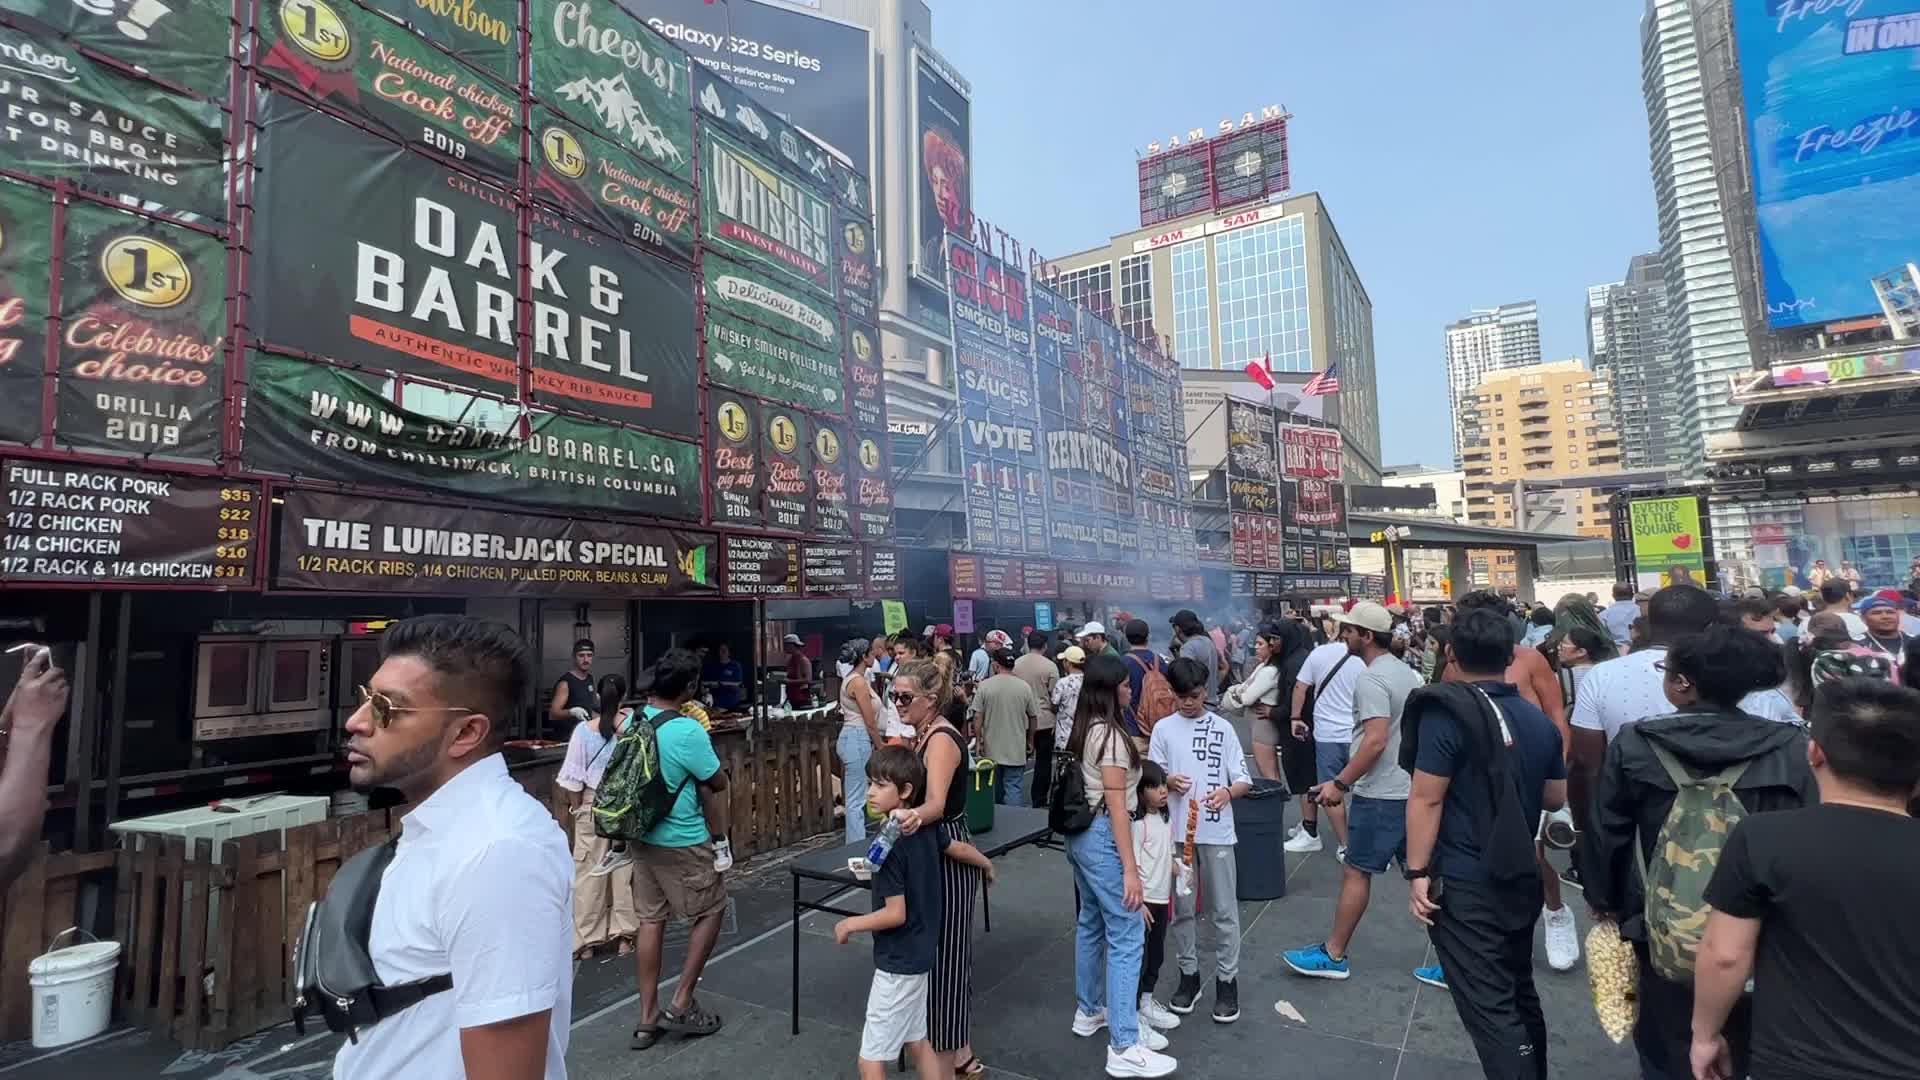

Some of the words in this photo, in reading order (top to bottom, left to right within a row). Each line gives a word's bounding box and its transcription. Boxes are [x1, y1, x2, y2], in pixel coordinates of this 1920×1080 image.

[554, 1, 675, 99] Cheers!
[648, 18, 723, 52] Galaxy
[762, 45, 822, 72] Series
[1846, 19, 1878, 53] IN
[370, 40, 457, 91] National
[457, 83, 516, 117] chicken
[772, 73, 796, 85] Store
[8, 104, 72, 135] FOR
[70, 102, 177, 148] SAUCE
[374, 72, 457, 120] Cook
[462, 113, 513, 145] off
[424, 127, 467, 159] 2019
[1148, 128, 1205, 154] SAM
[1219, 103, 1281, 133] SAM
[1795, 106, 1918, 163] Freezie
[41, 135, 178, 186] DRINKING
[598, 159, 652, 192] National
[653, 184, 690, 208] chicken
[602, 183, 652, 216] Cook
[657, 208, 690, 232] off
[733, 224, 773, 252] FINEST
[1150, 229, 1184, 247] SAM
[1223, 211, 1260, 228] SAM
[414, 197, 568, 299] OAK
[589, 265, 623, 315] &
[355, 241, 648, 383] BARREL
[728, 280, 794, 315] Delicious
[956, 302, 1002, 335] SMOKED
[375, 327, 482, 370] AUTHENTIC
[489, 362, 566, 389] WHKEY
[570, 382, 593, 394] RIB
[599, 388, 639, 402] SAUCE
[714, 324, 752, 348] WHISKEY
[790, 351, 817, 372] PULLED
[74, 352, 208, 387] choice
[740, 361, 756, 376] Get
[96, 393, 192, 422] ORILLIA
[106, 418, 179, 445] 2019
[967, 420, 1033, 452] VOTE
[310, 430, 377, 455] FROM
[529, 467, 595, 488] BRITISH
[603, 476, 677, 497] COLUMBIA
[716, 448, 754, 470] Best
[771, 462, 801, 480] Best
[1048, 431, 1129, 488] KENTUCKY
[10, 467, 60, 486] FULL
[64, 472, 117, 491] RACK
[122, 478, 170, 496] PORK
[220, 488, 250, 502] $35
[767, 476, 806, 492] Sauce
[815, 470, 846, 487] Best
[8, 490, 36, 507] 1/2
[41, 492, 95, 511] RACK
[100, 497, 151, 515] PORK
[219, 508, 251, 521] $22
[1632, 500, 1679, 514] EVENTS
[1634, 513, 1650, 523] AT
[1653, 511, 1675, 523] THE
[6, 512, 34, 529] 1/2
[38, 514, 123, 534] CHICKEN
[218, 527, 249, 541] $18
[303, 518, 371, 550] THE
[383, 526, 573, 563] LUMBERJACK
[579, 539, 668, 567] SPECIAL
[1635, 522, 1683, 536] SQUARE
[4, 535, 30, 551] 1/4
[36, 536, 121, 555] CHICKEN
[216, 546, 247, 559] $10
[1, 557, 28, 573] 1/2
[34, 558, 89, 576] RACK
[92, 561, 106, 575] &
[112, 562, 135, 576] 1/4
[140, 562, 213, 578] CHICKEN
[214, 566, 246, 577] $31
[297, 555, 321, 571] 1/2
[325, 558, 374, 575] RACK
[378, 559, 417, 578] RIBS,
[422, 564, 442, 578] 1/4
[446, 565, 508, 582] CHICKEN,
[511, 567, 556, 582] PULLED
[559, 569, 593, 584] PORK,
[595, 570, 630, 584] BEANS
[630, 571, 639, 583] &
[641, 572, 668, 585] SLAW
[1205, 730, 1225, 823] FURTHR
